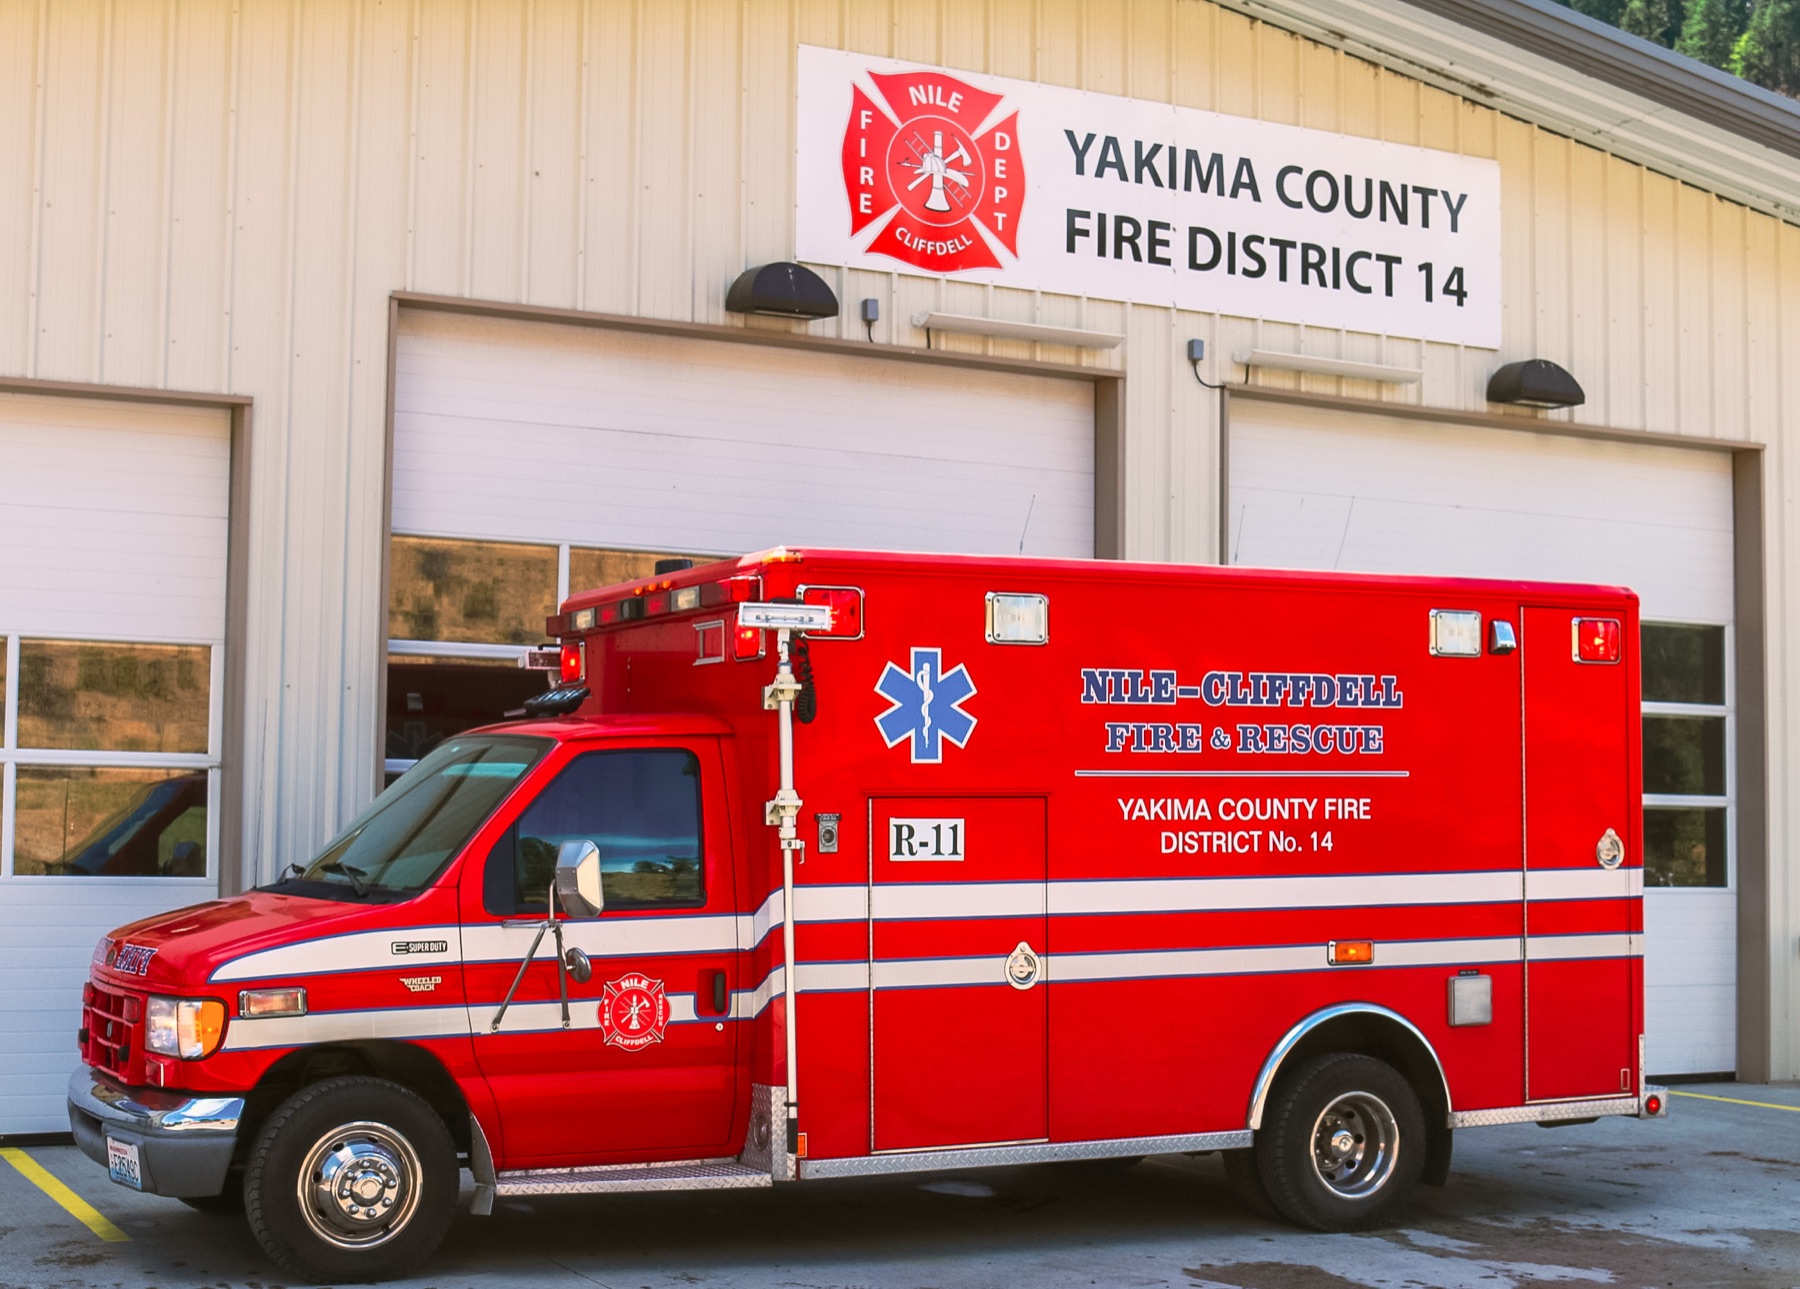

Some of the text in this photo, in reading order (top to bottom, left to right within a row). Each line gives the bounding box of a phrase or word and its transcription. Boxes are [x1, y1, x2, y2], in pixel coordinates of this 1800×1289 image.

[909, 85, 963, 113] NILE
[859, 110, 874, 214] FIRE
[993, 132, 1011, 231] DEPT
[1064, 129, 1468, 233] YAKIMA COUNTY
[895, 227, 973, 256] CLIFFDELL
[1066, 208, 1468, 307] FIRE DISTRICT 14
[1081, 668, 1403, 708] NILE-CLIFFDELL
[1105, 722, 1383, 754] FIRE & RESCUE
[1117, 798, 1371, 821] YAKIMA COUNTY FIRE
[892, 823, 961, 856] R-11
[1160, 830, 1333, 854] DISTRICT No. 14
[409, 943, 429, 952] SUPER
[430, 942, 447, 951] DUTY
[399, 976, 442, 985] WHEELED
[407, 984, 435, 992] COACH
[620, 978, 649, 990] NILE
[615, 1035, 653, 1045] CLIFFDELL
